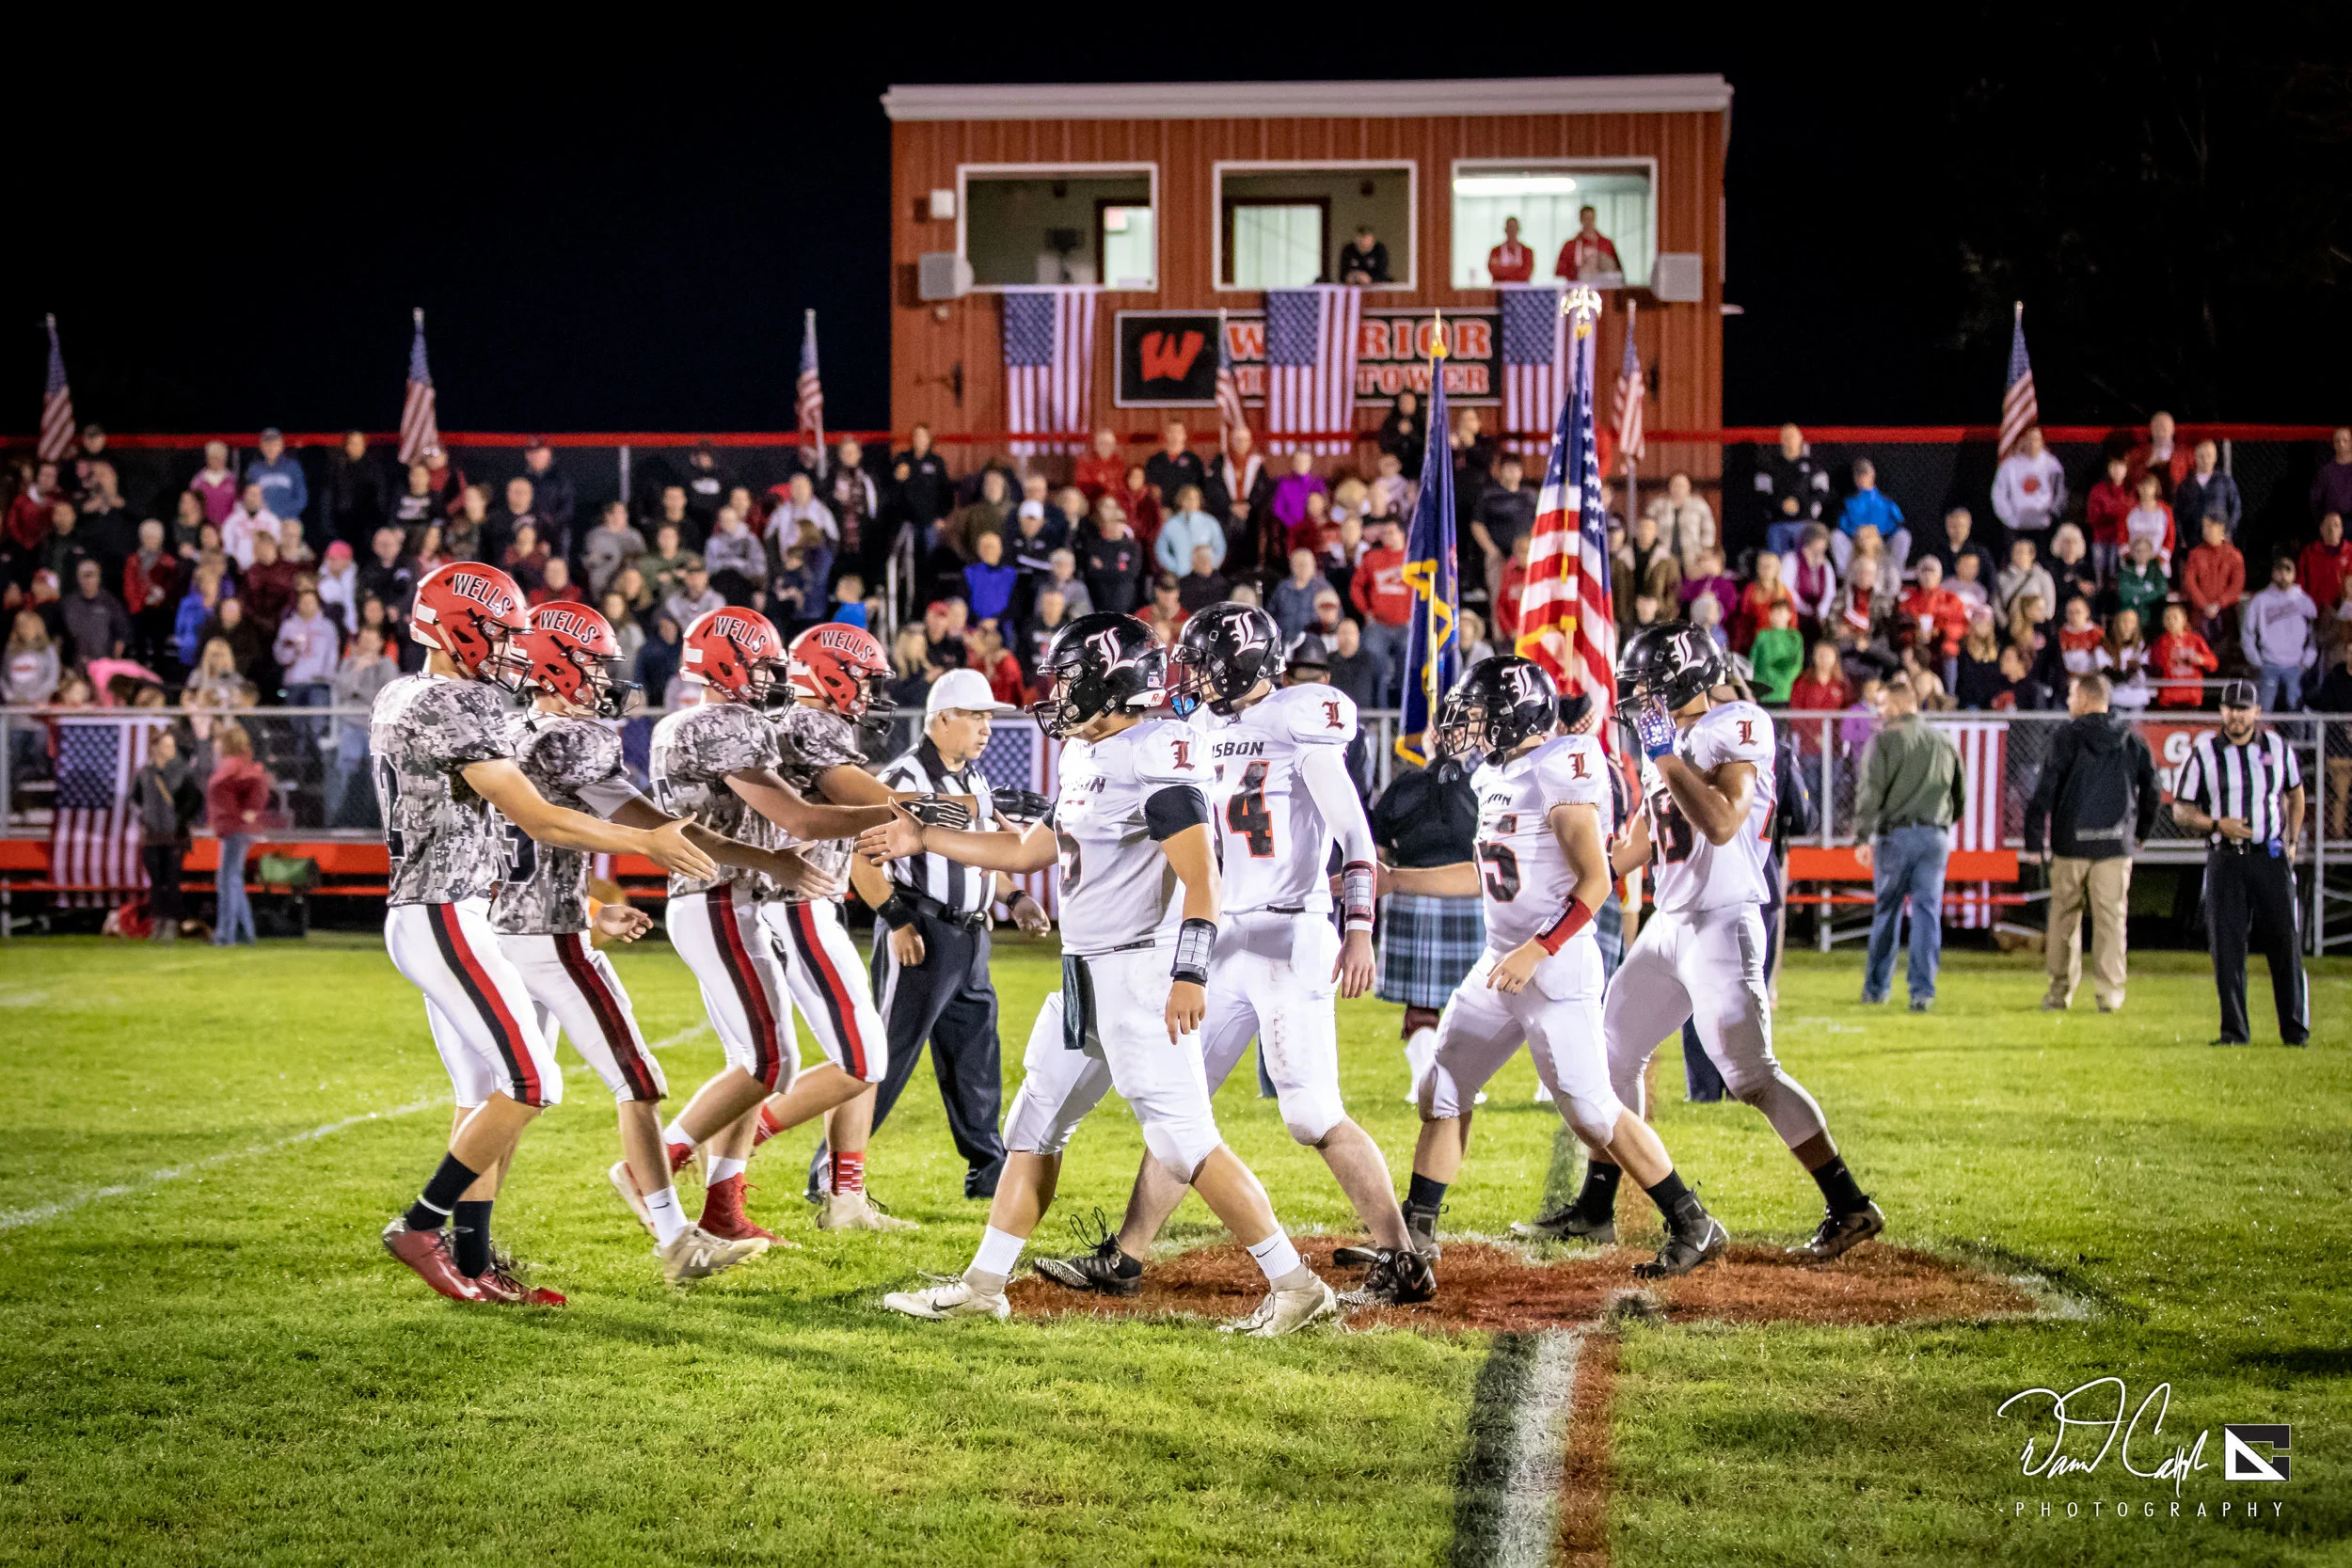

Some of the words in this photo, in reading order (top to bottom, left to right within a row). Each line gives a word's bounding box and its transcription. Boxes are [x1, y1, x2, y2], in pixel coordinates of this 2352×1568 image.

[453, 573, 513, 618] WELLS
[539, 610, 597, 645] WELLS
[714, 616, 767, 656] WELLS
[1222, 612, 1267, 656] L
[820, 630, 873, 663] WELLS
[1085, 626, 1137, 678] L
[1666, 631, 1707, 675] L
[1502, 664, 1545, 707] L
[1322, 701, 1344, 729] L
[1212, 741, 1264, 759] ISBON
[1737, 720, 1759, 746] L
[1170, 739, 1195, 769] L
[1568, 752, 1592, 780] L
